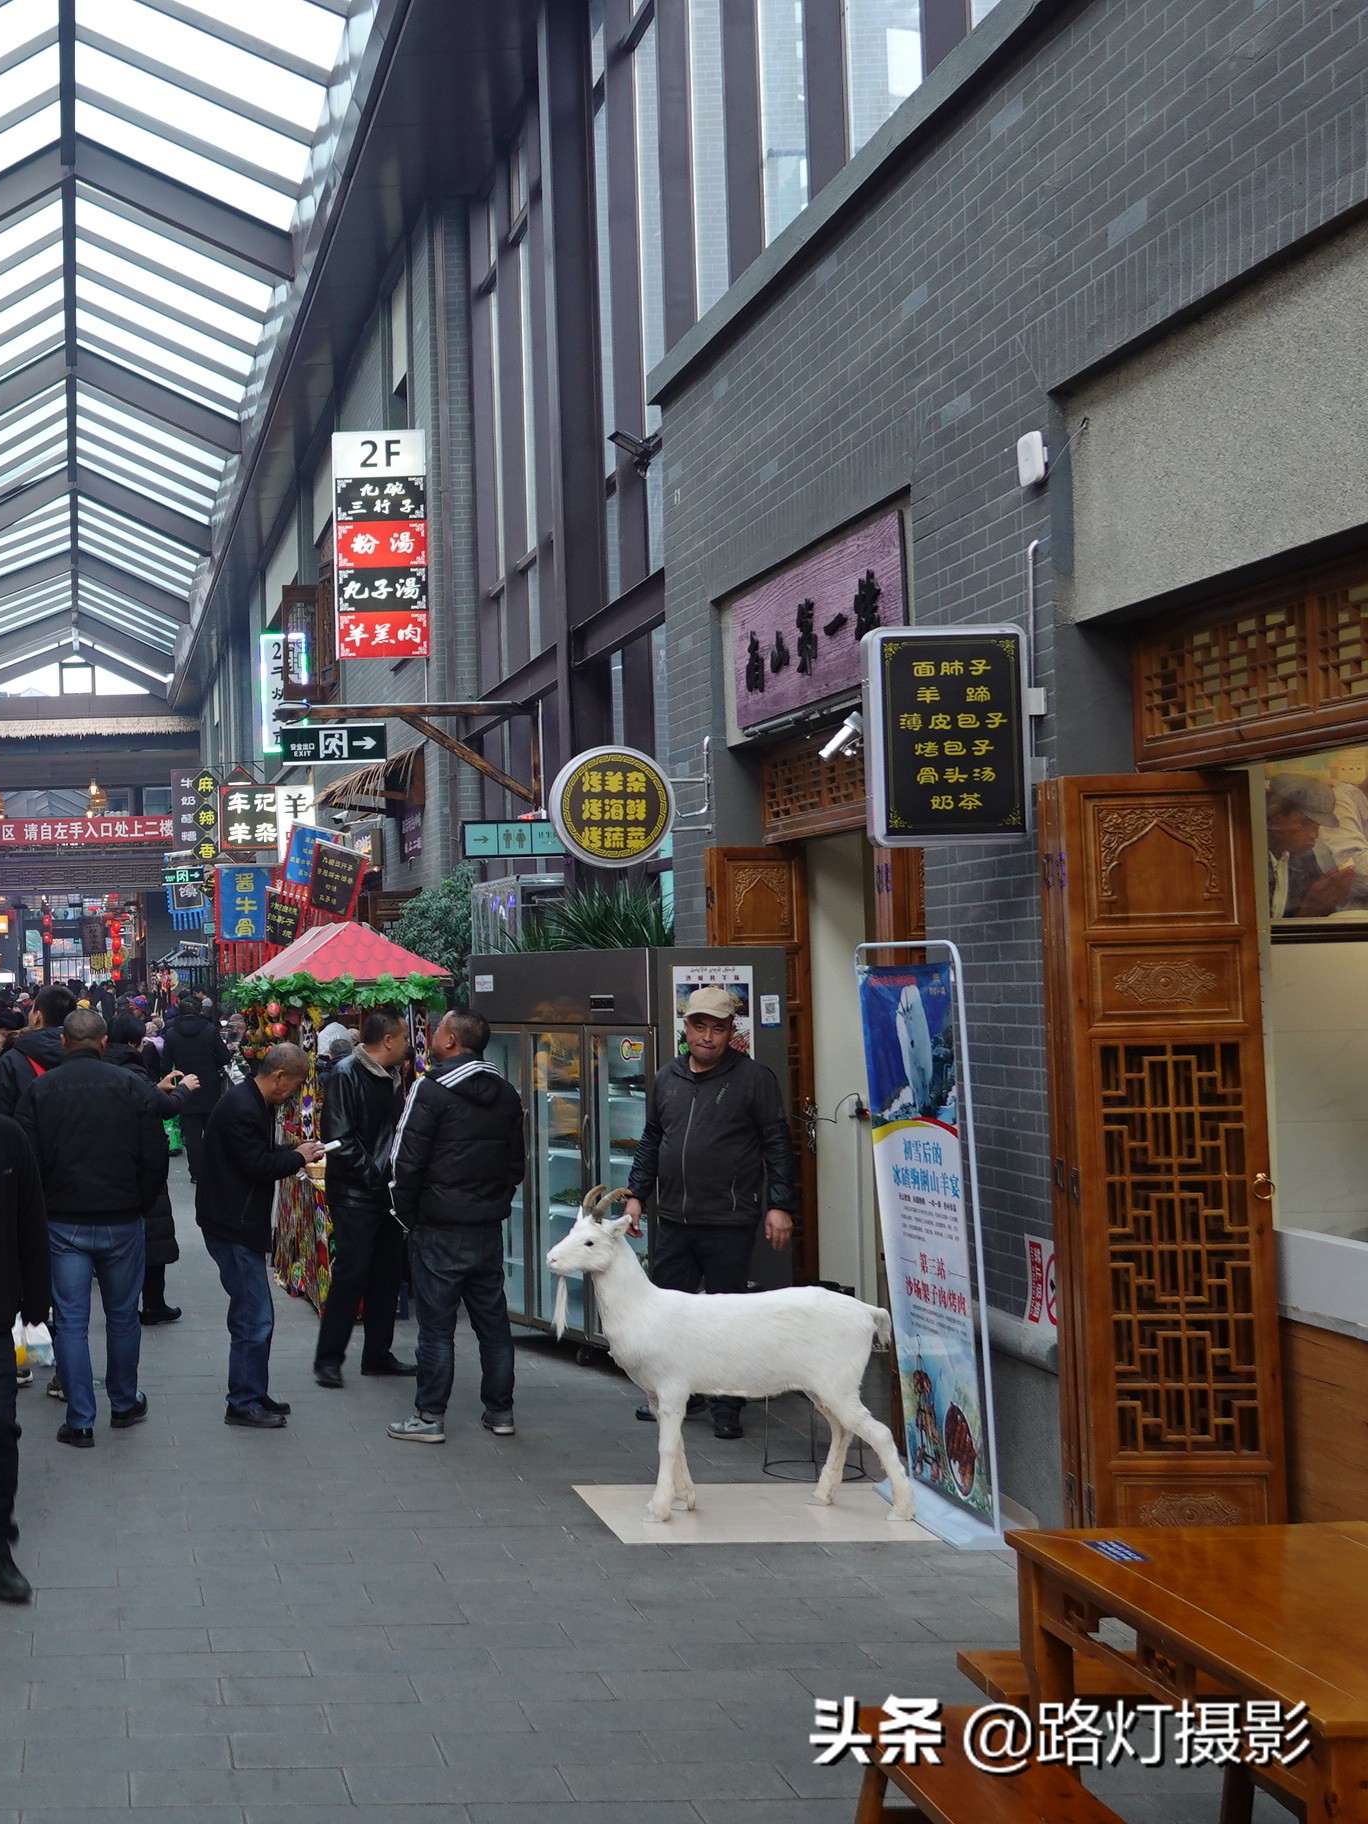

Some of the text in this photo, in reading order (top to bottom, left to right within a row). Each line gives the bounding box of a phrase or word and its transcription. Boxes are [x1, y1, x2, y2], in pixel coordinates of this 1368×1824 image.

[360, 439, 401, 468] 2F
[360, 482, 405, 497] 九碗
[348, 499, 415, 516] 三行子
[911, 659, 992, 677] 面肺子
[916, 685, 991, 704] 羊蹄
[899, 712, 1008, 731] 薄皮包子
[290, 743, 315, 751] 安全出口
[914, 739, 995, 758] 烤包子
[581, 770, 646, 793] 烤羊杂
[916, 766, 997, 786] 骨头汤
[227, 792, 277, 814] 车记
[581, 799, 647, 821] 烤海鲜
[930, 793, 983, 812] 奶茶
[197, 776, 216, 859] 麻辣香
[24, 819, 174, 841] 请自左手入口处上二楼
[227, 823, 278, 844] 羊杂
[581, 826, 647, 850] 烤蔬菜
[234, 873, 258, 937] 酱牛骨
